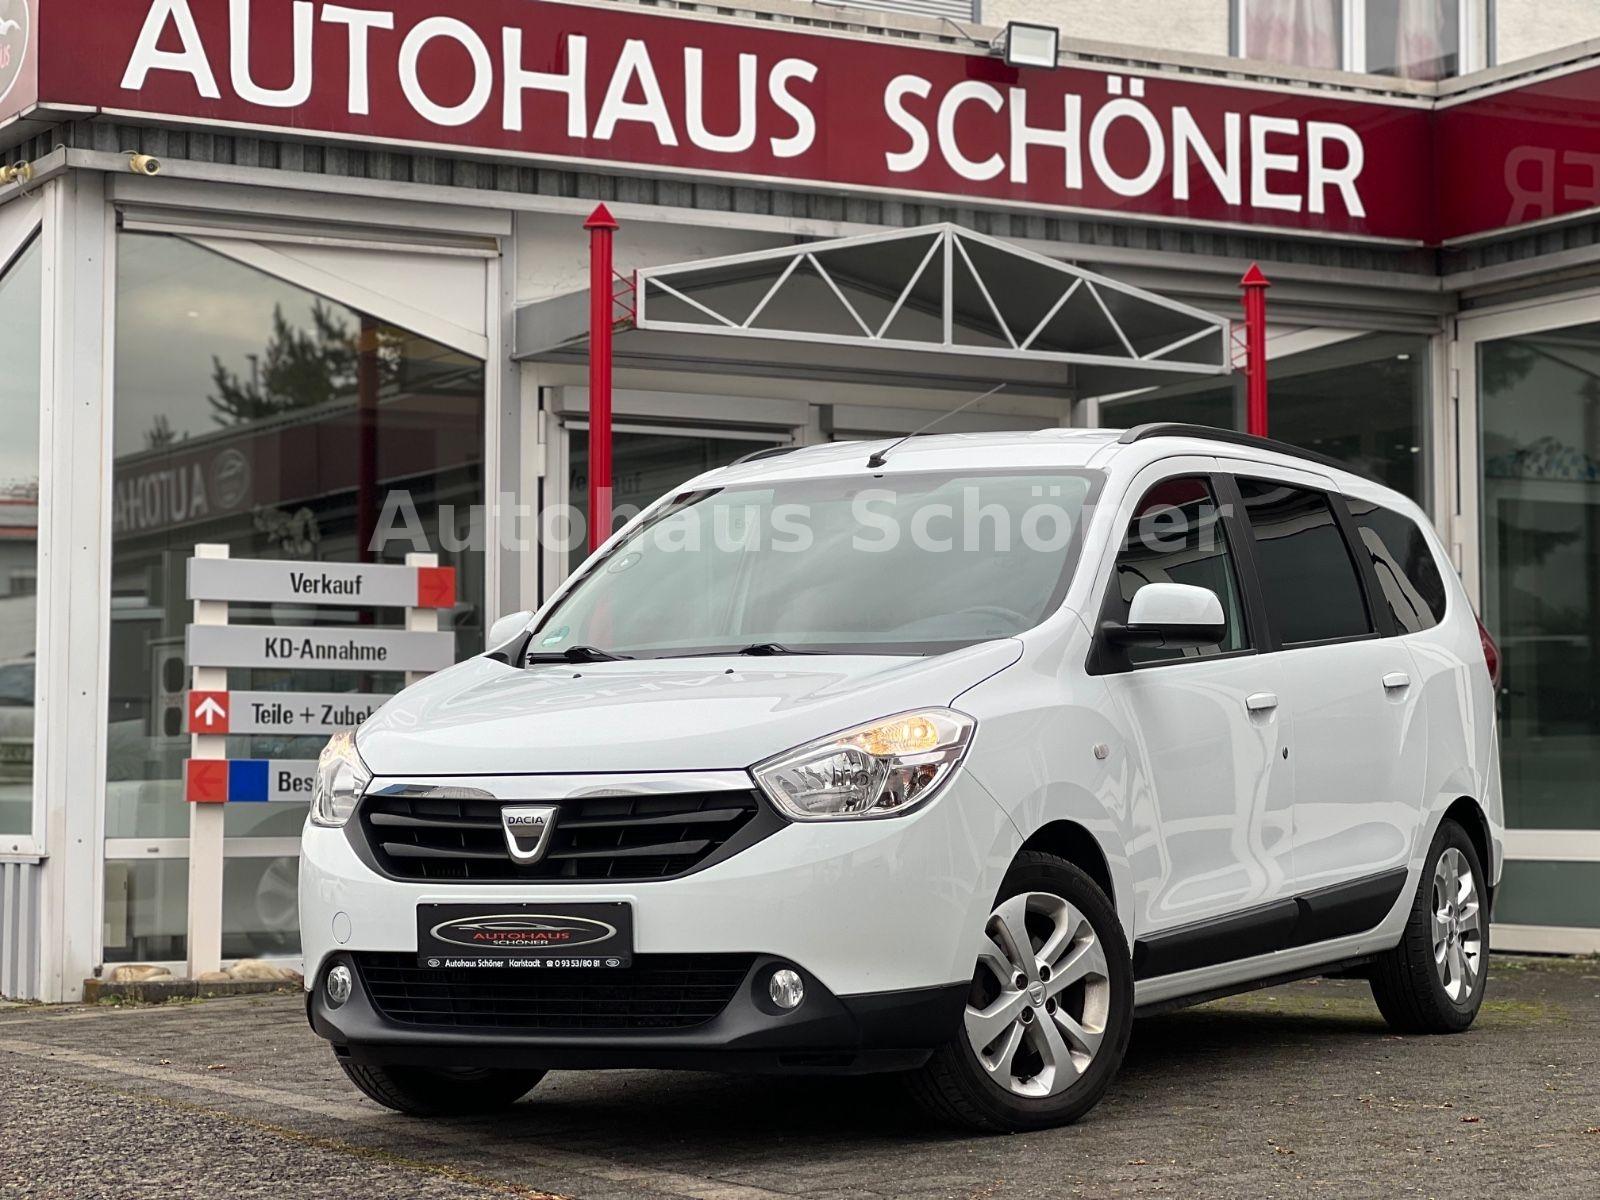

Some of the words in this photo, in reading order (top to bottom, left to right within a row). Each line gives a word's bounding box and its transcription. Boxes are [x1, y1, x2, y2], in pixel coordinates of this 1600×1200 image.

[120, 0, 816, 158] AUTOHAUS
[884, 74, 1367, 218] SCHÖNER
[290, 572, 363, 595] Verkauf
[265, 637, 388, 661] KD-Annahme
[251, 703, 294, 725] Teile
[507, 815, 544, 825] DACIA
[473, 932, 571, 940] AUTOHAUS
[445, 959, 477, 968] Autohaus
[477, 959, 504, 968] Schöner
[508, 959, 541, 968] Karlstadt
